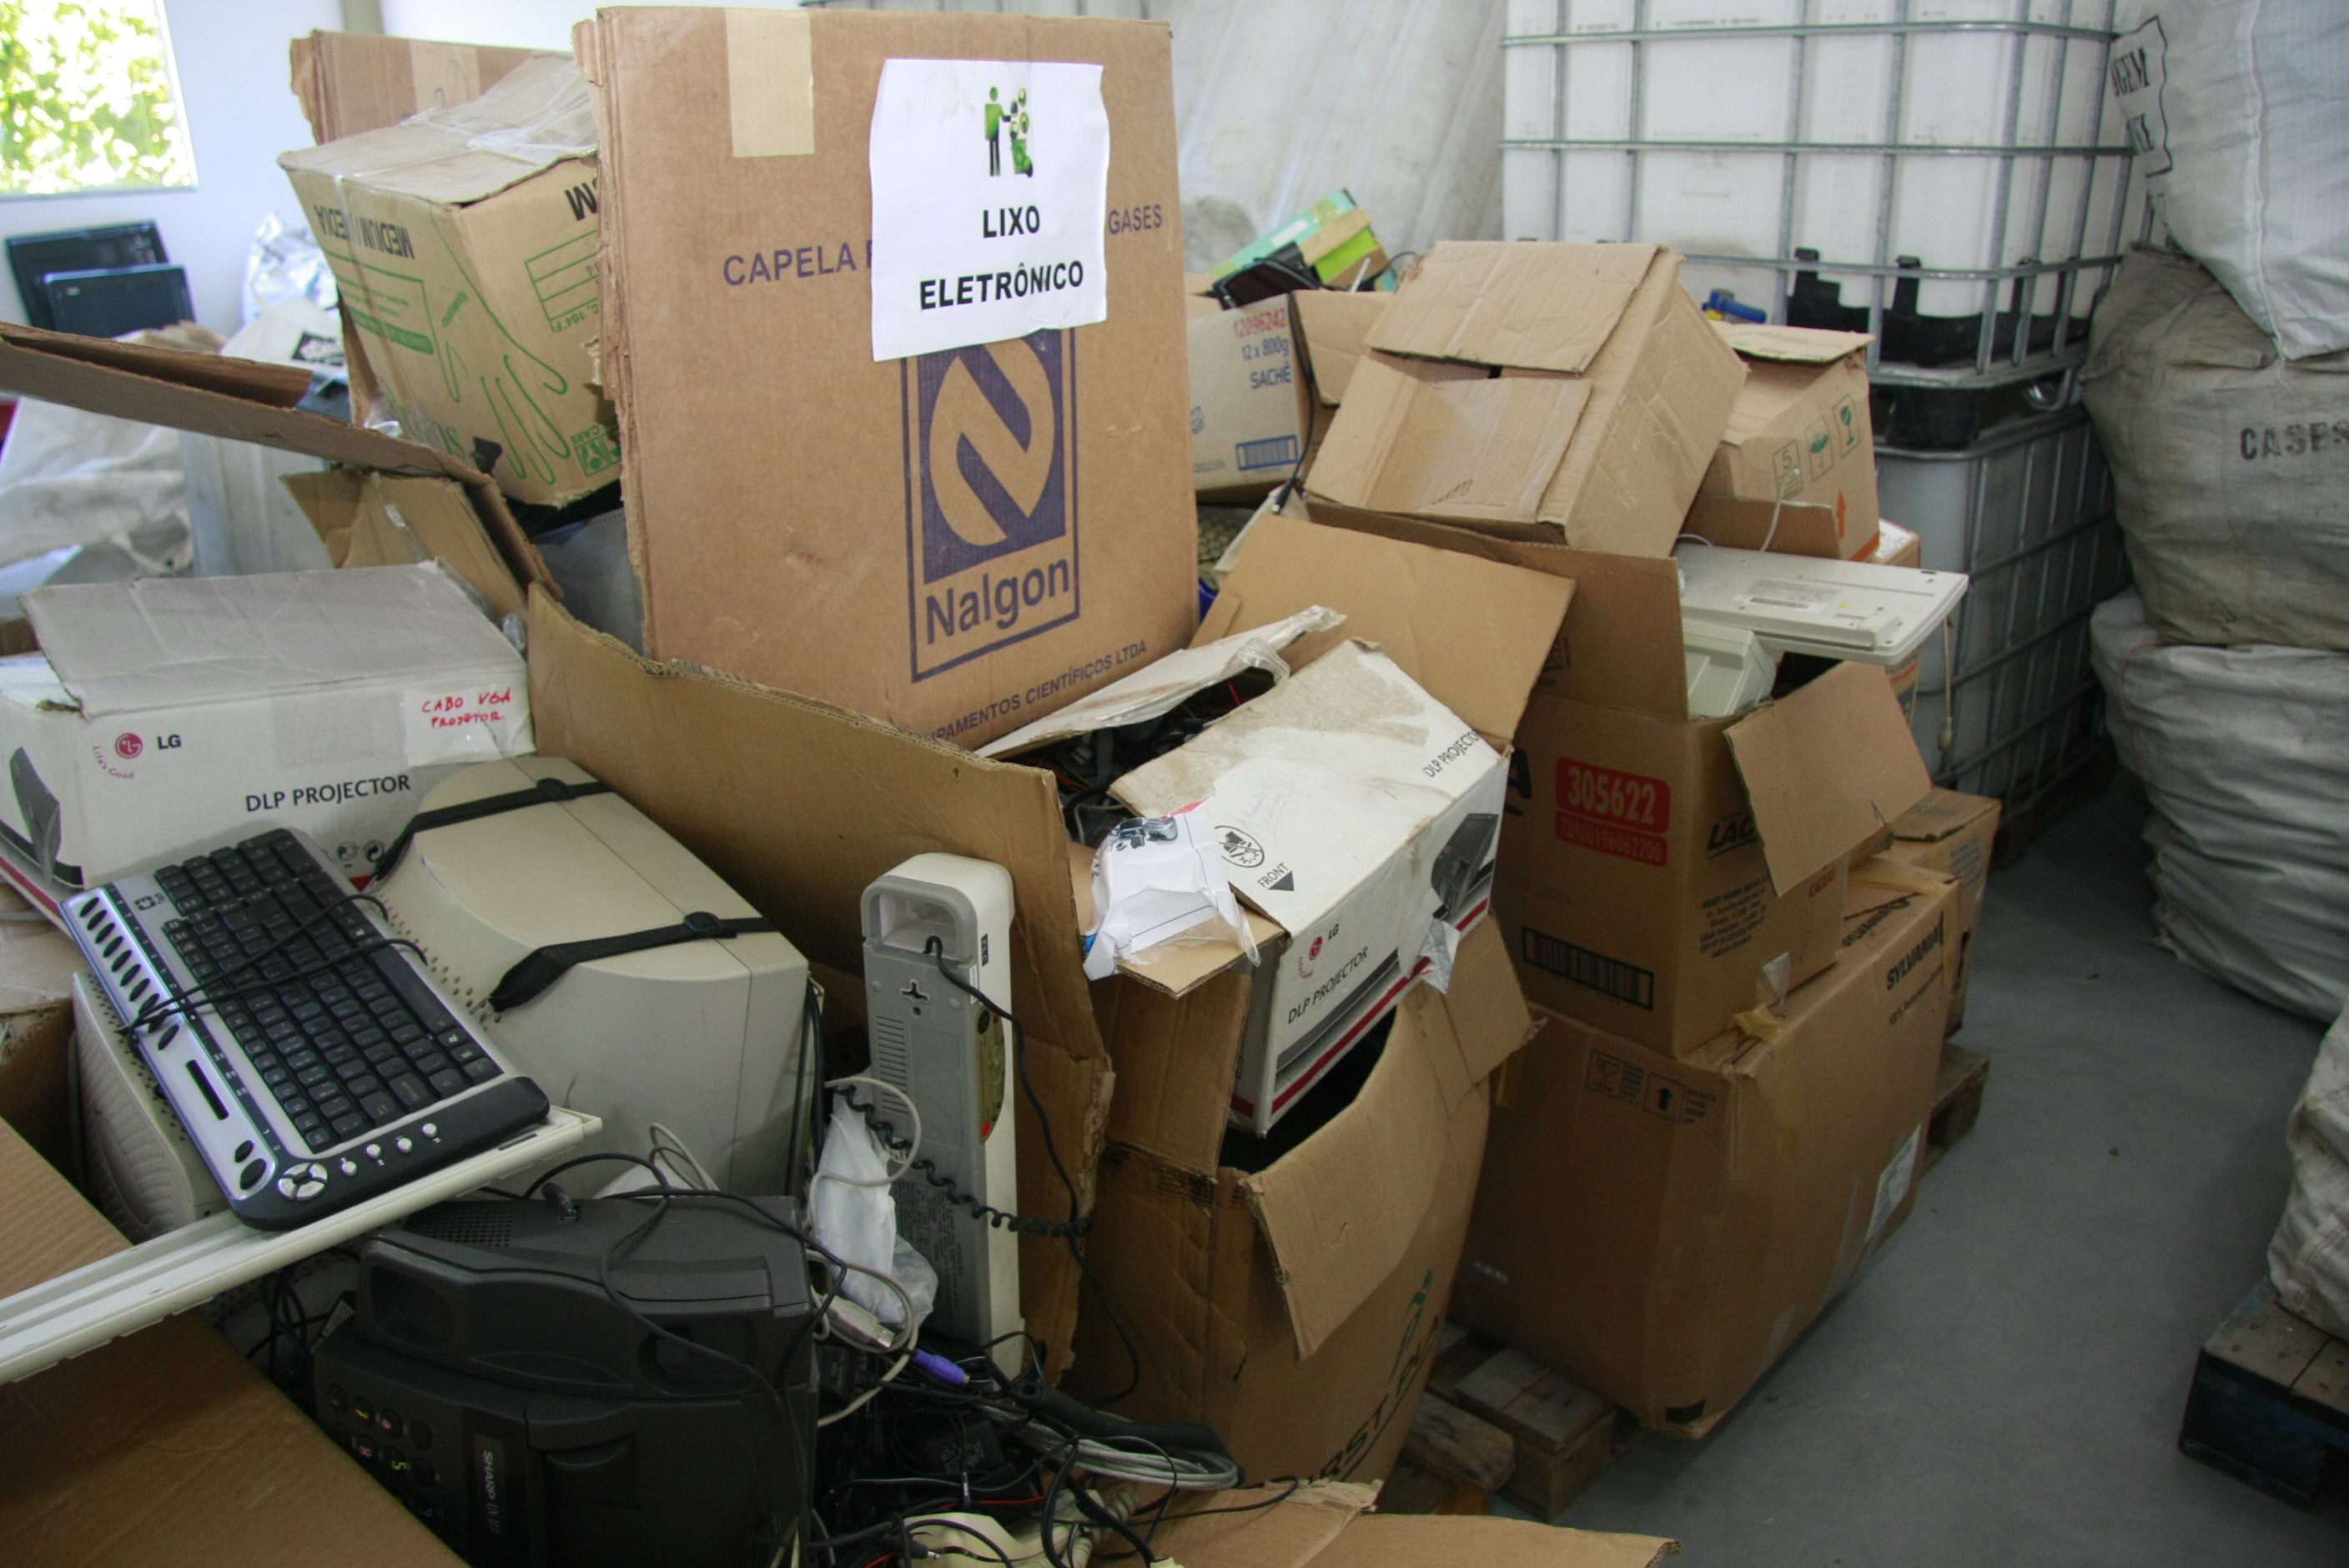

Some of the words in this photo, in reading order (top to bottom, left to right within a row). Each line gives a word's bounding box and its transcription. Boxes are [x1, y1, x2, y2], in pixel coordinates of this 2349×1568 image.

[982, 204, 1041, 239] LIXO
[722, 242, 857, 287] CAPELA
[1107, 203, 1164, 236] GASES
[919, 259, 1084, 311] ELETRÔNICO
[570, 425, 601, 445] CARE
[1782, 449, 1793, 470] 5
[925, 557, 1070, 646] Nalgon
[1025, 652, 1113, 705] CIENTÍFICOS
[1115, 640, 1148, 665] LTDA
[421, 696, 464, 713] CABO
[478, 687, 512, 706] VGA
[156, 733, 183, 751] LG
[108, 767, 135, 780] Good
[1422, 758, 1443, 778] DLP
[245, 792, 285, 813] DLP
[292, 774, 411, 806] PROJECTOR
[1567, 765, 1657, 826] 305622
[1256, 862, 1290, 889] FRONT
[1328, 922, 1340, 942] LG
[1287, 998, 1310, 1025] DLP
[1312, 945, 1369, 1007] PROJECTOR
[483, 1450, 496, 1500] SHARP
